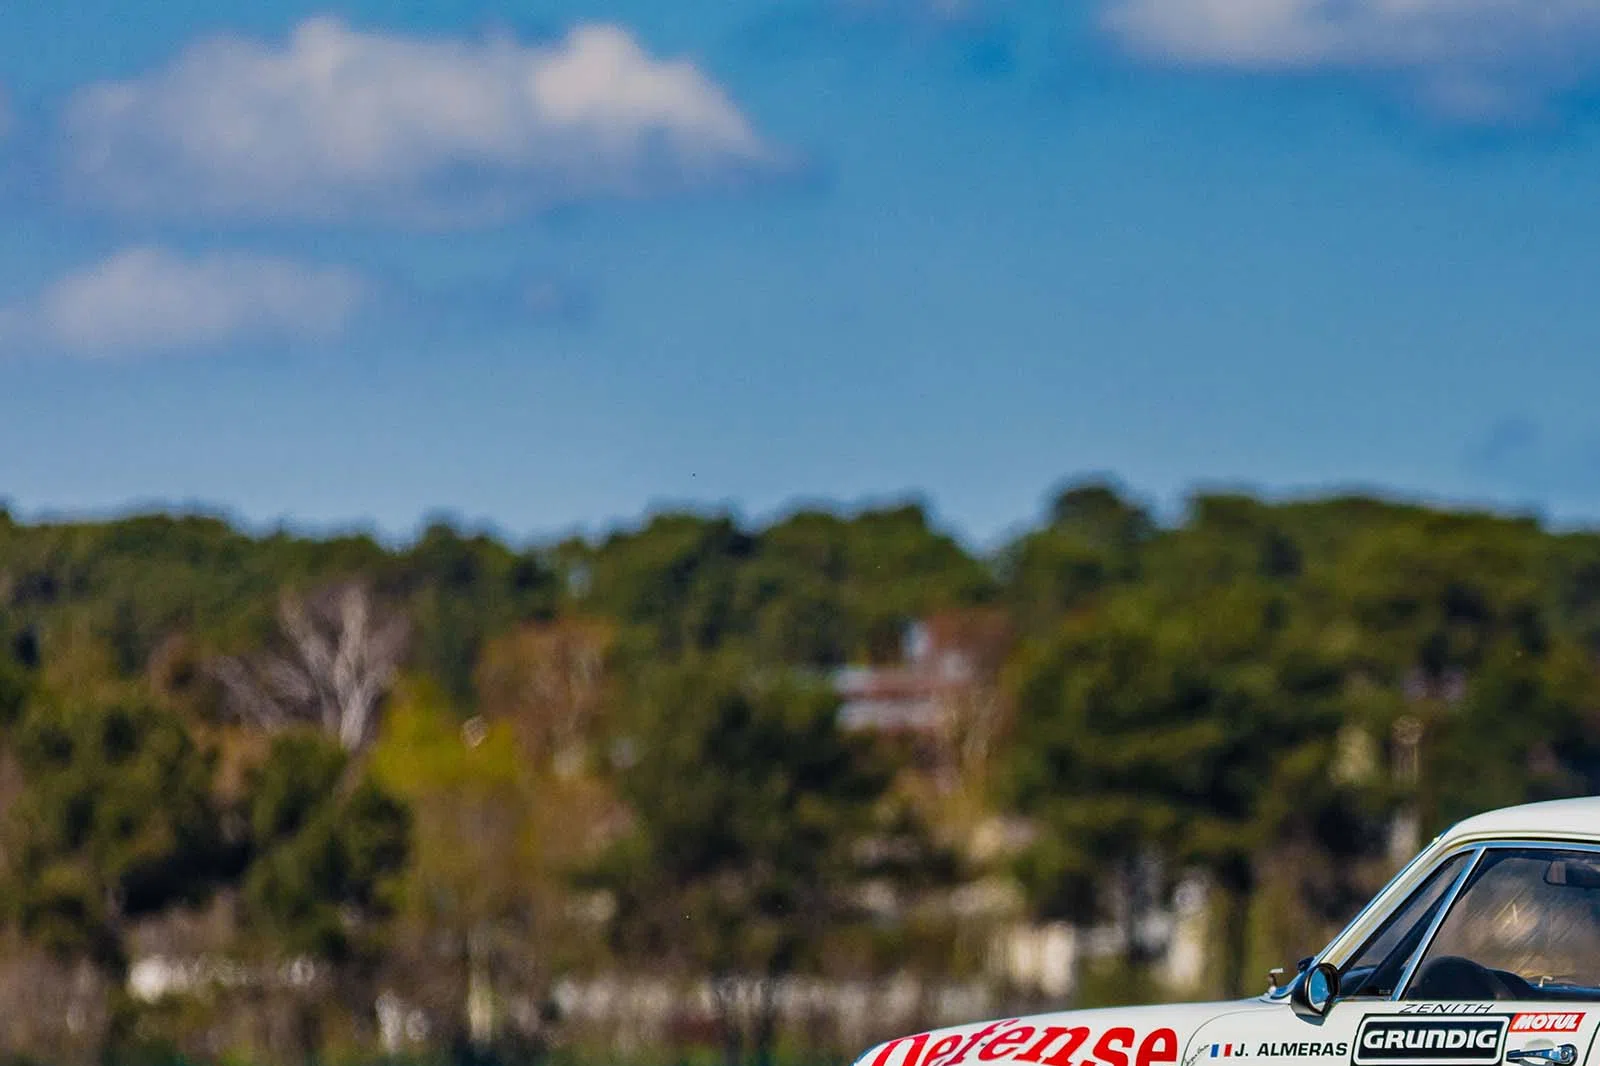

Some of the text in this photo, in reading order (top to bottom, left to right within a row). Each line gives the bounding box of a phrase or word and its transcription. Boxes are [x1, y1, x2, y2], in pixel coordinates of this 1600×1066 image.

[1398, 1003, 1494, 1014] ZENITH
[1512, 1014, 1580, 1030] MOTUL
[1363, 1028, 1498, 1049] GRUNDIG
[1234, 1042, 1348, 1057] J. ALMERAS
